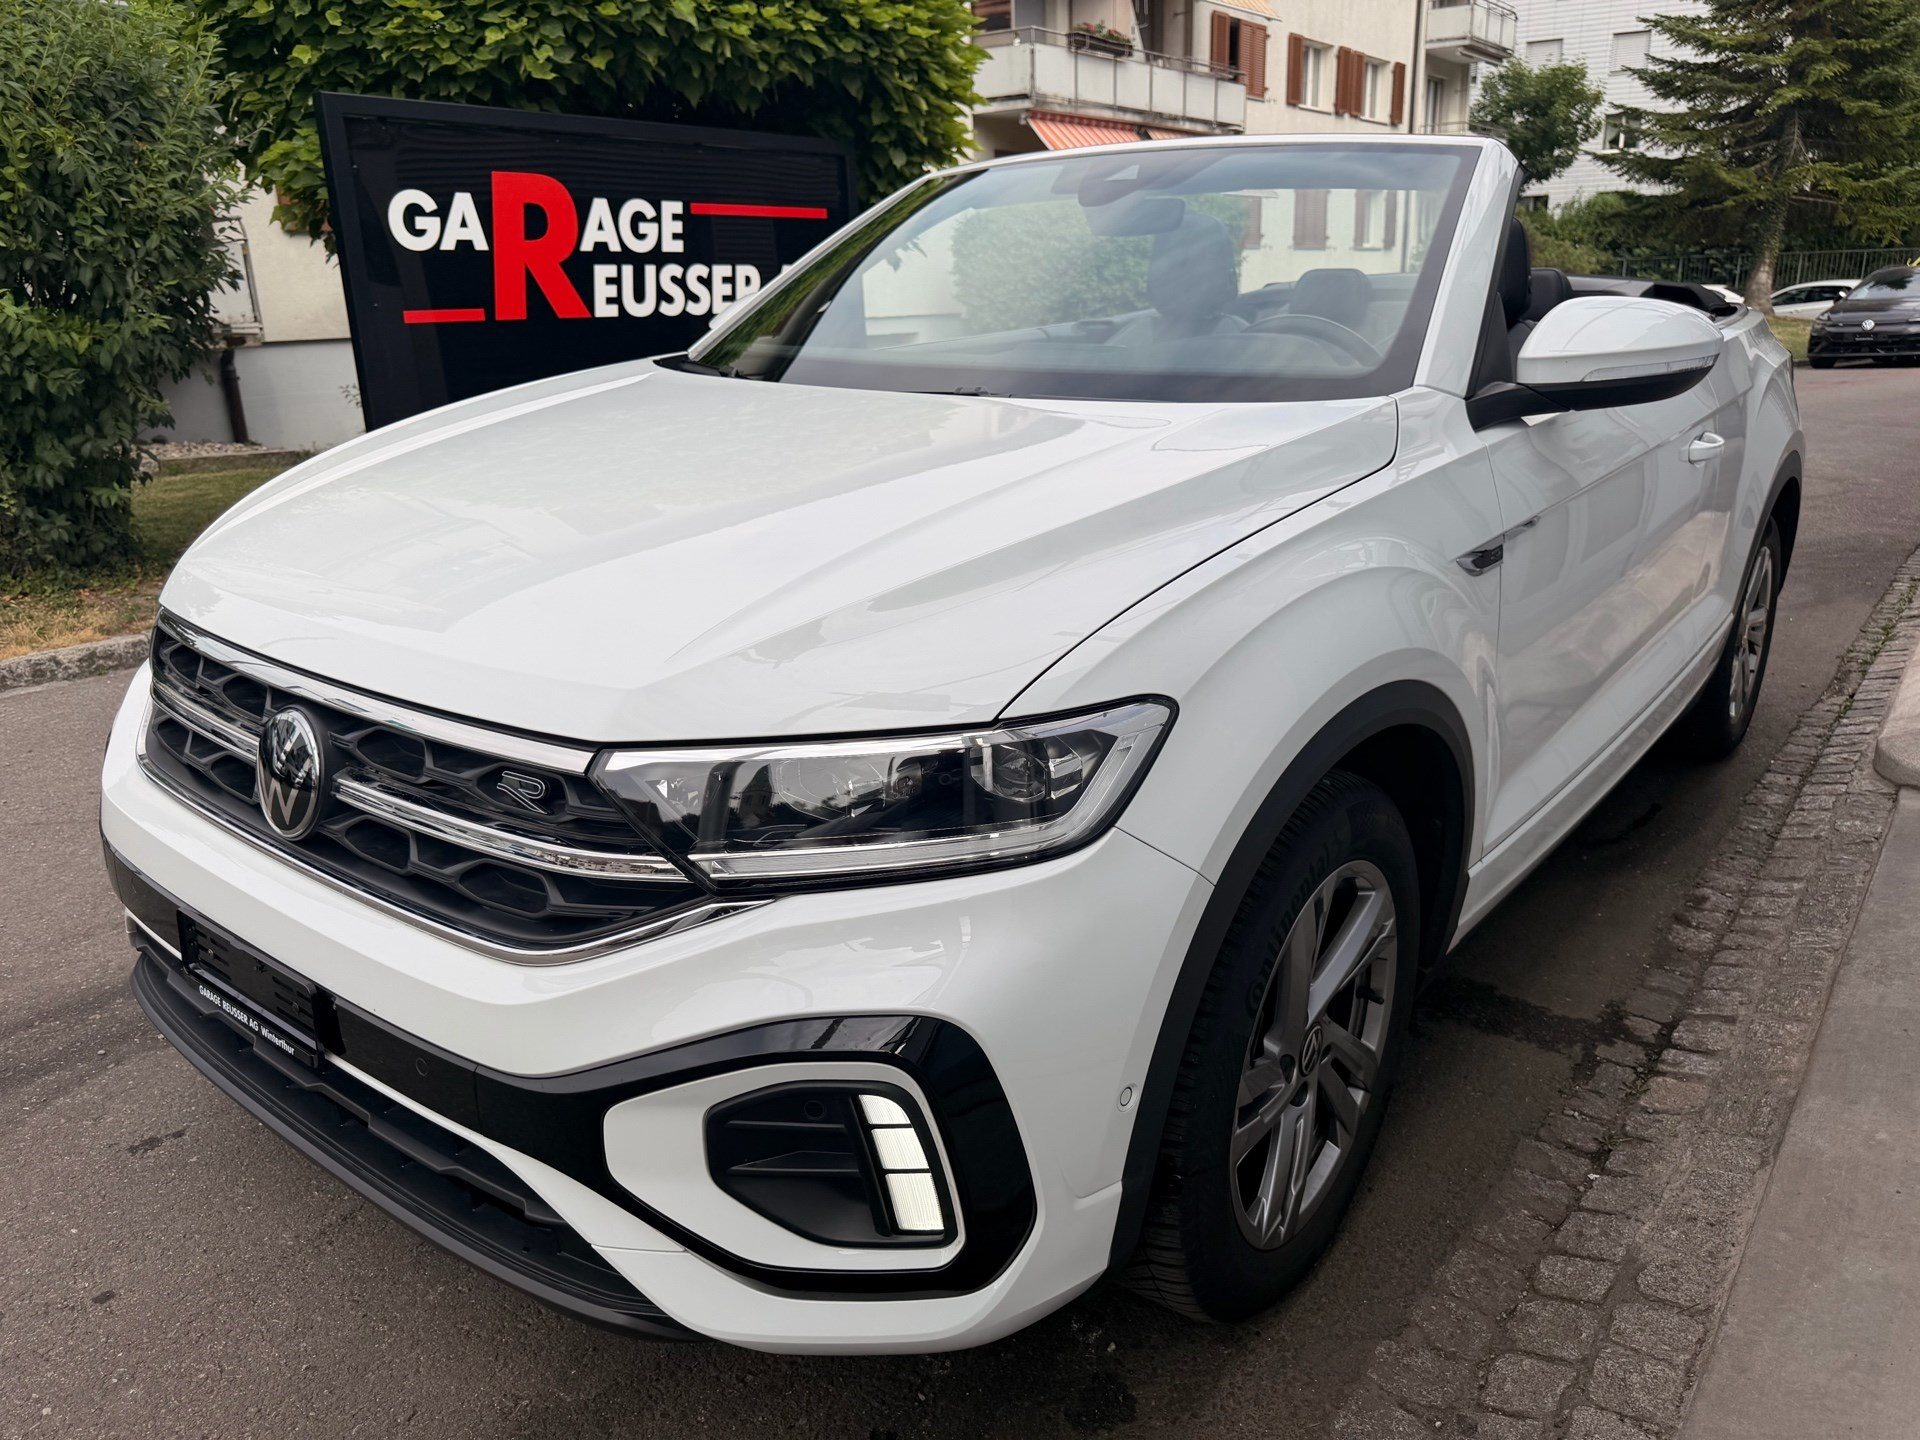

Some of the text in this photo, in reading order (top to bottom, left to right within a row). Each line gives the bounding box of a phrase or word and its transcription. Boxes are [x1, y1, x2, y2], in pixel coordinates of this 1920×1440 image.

[387, 170, 685, 321] GARAGE
[199, 985, 295, 1056] GARAGE REUSSER AG Winterthur
